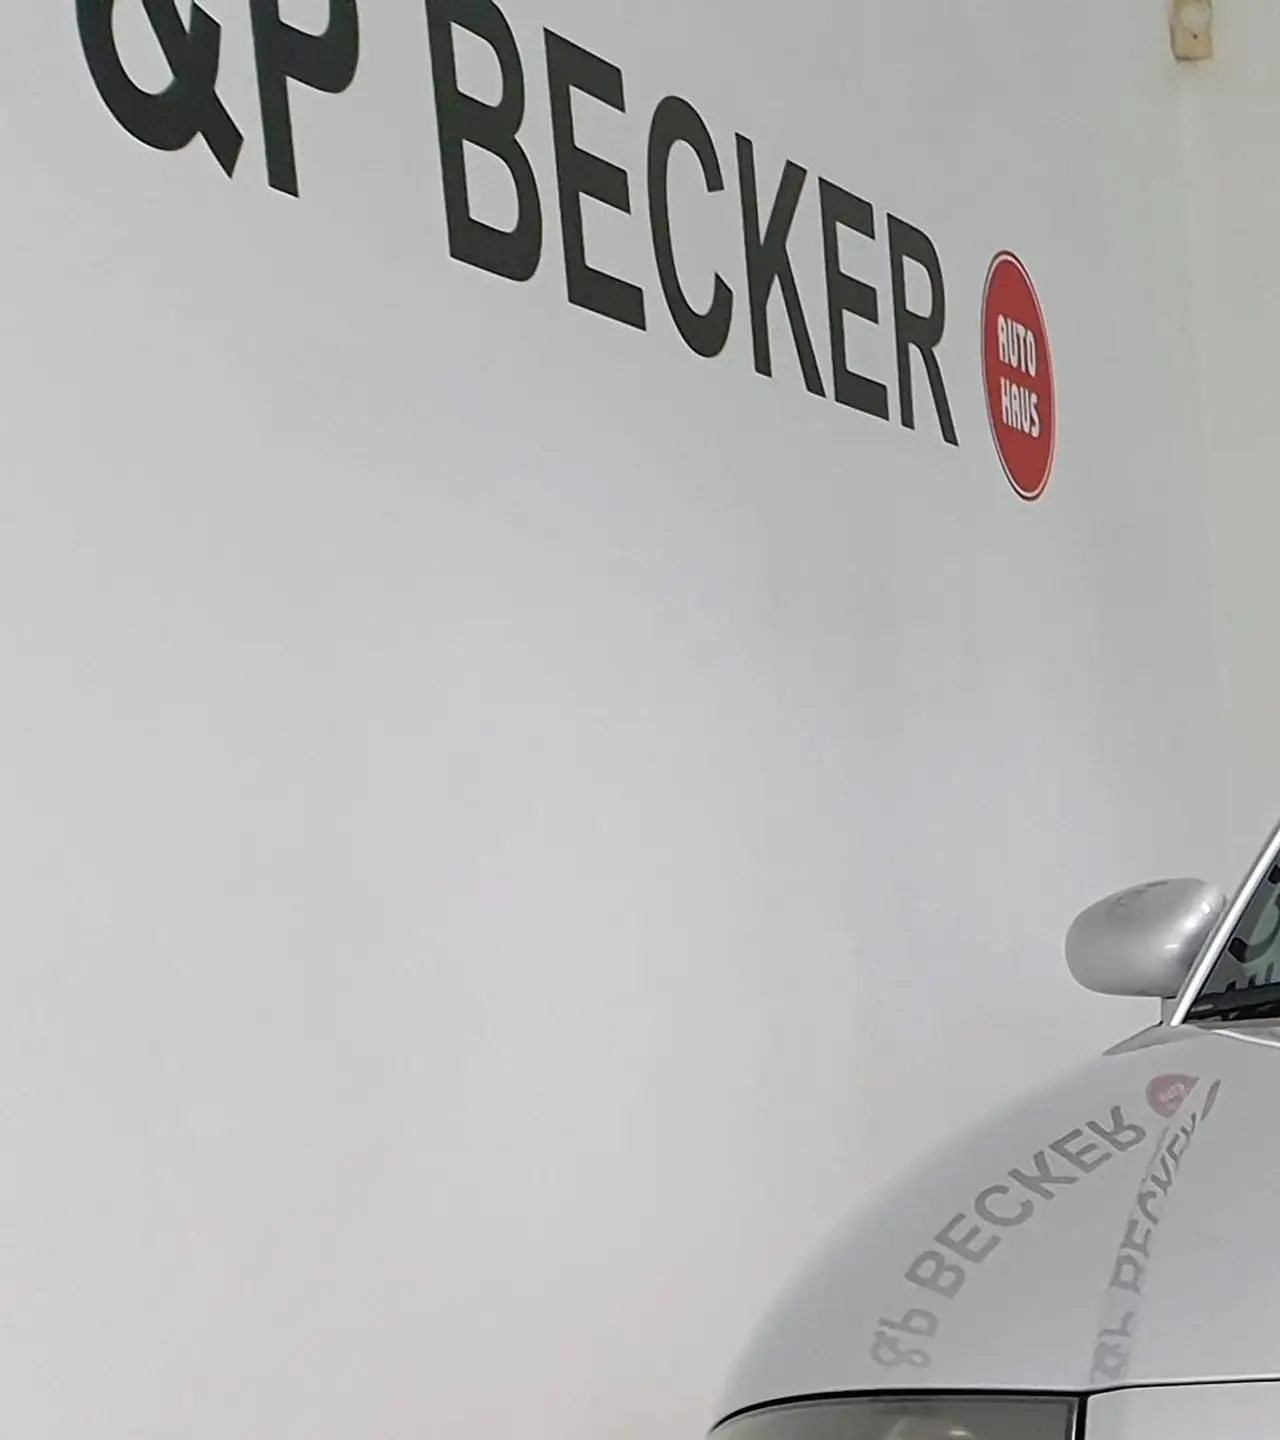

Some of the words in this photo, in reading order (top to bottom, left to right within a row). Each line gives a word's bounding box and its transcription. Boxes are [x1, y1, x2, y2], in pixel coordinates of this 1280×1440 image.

[424, 0, 959, 447] BECKER
[997, 314, 1037, 378] AUTO
[1000, 377, 1040, 438] HAUS
